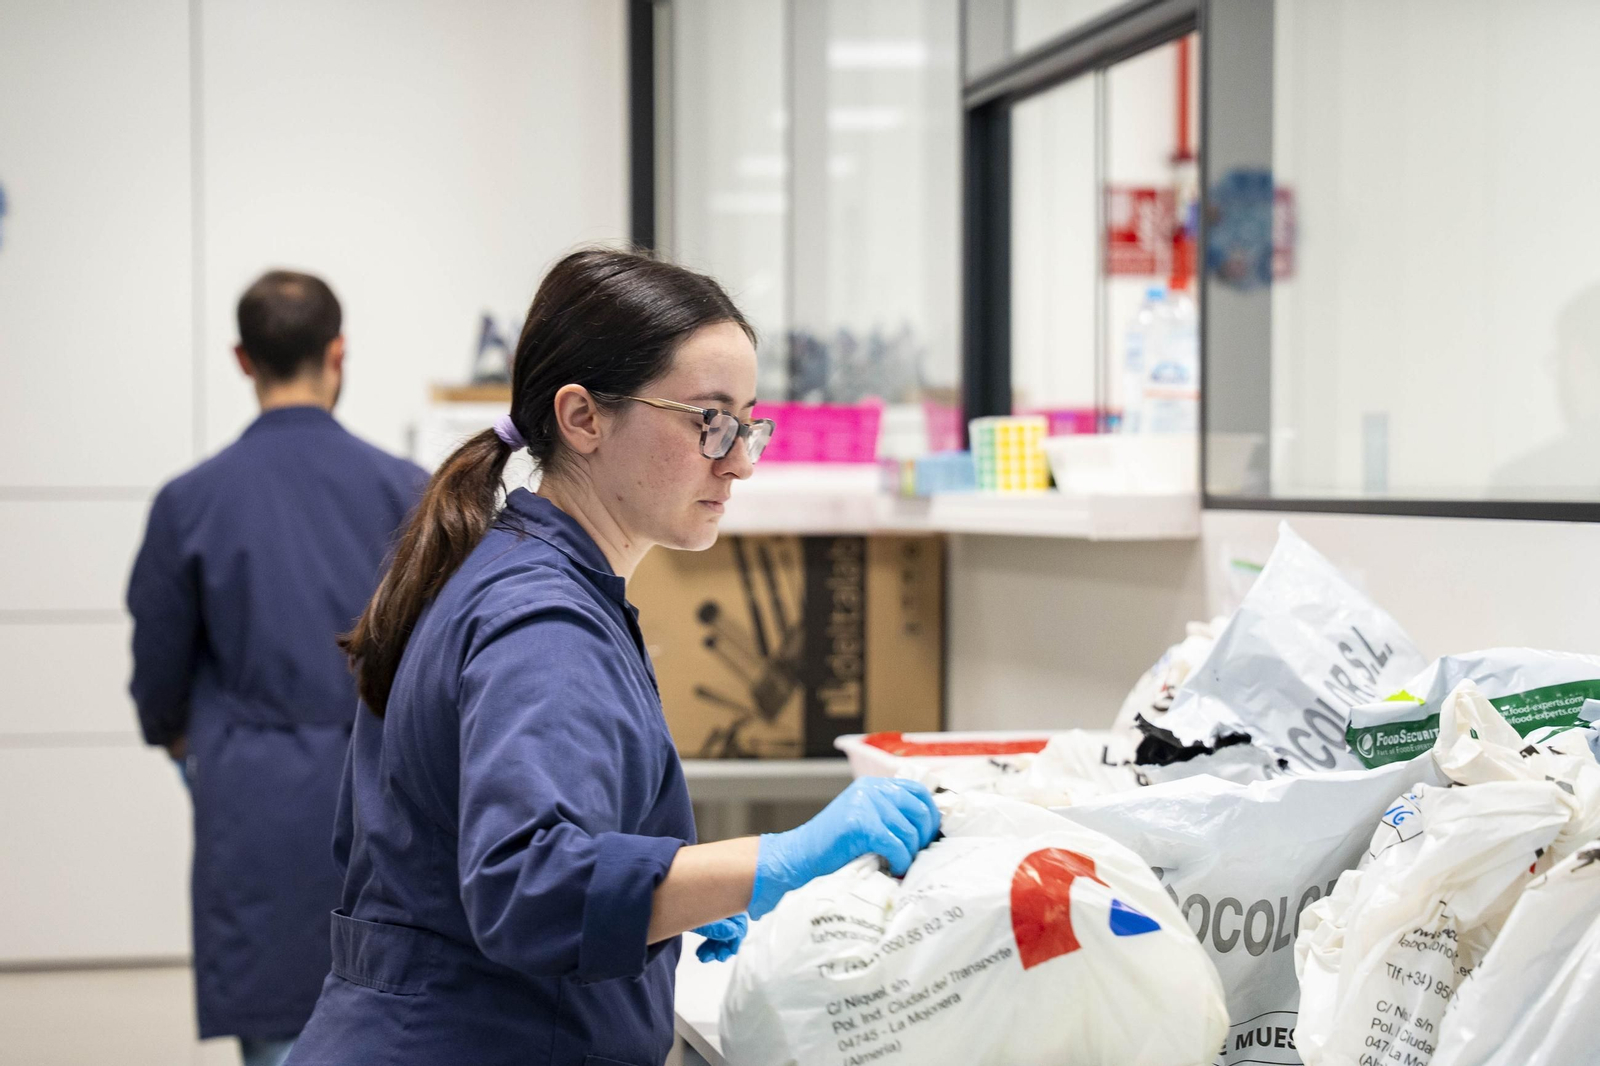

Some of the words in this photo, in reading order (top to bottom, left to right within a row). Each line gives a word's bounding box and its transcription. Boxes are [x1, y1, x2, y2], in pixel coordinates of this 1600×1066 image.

[923, 917, 943, 936] 82
[943, 906, 964, 923] 30
[888, 986, 930, 1015] Ciudad
[931, 976, 948, 994] del
[948, 948, 1013, 983] Transporte
[1376, 1000, 1393, 1014] C/
[1414, 1017, 1433, 1034] s/n
[838, 1028, 879, 1052] 04745
[888, 1020, 906, 1034] La
[1365, 1035, 1391, 1053] 047
[1371, 1017, 1394, 1036] Pol.
[1400, 1029, 1436, 1057] Ciuda
